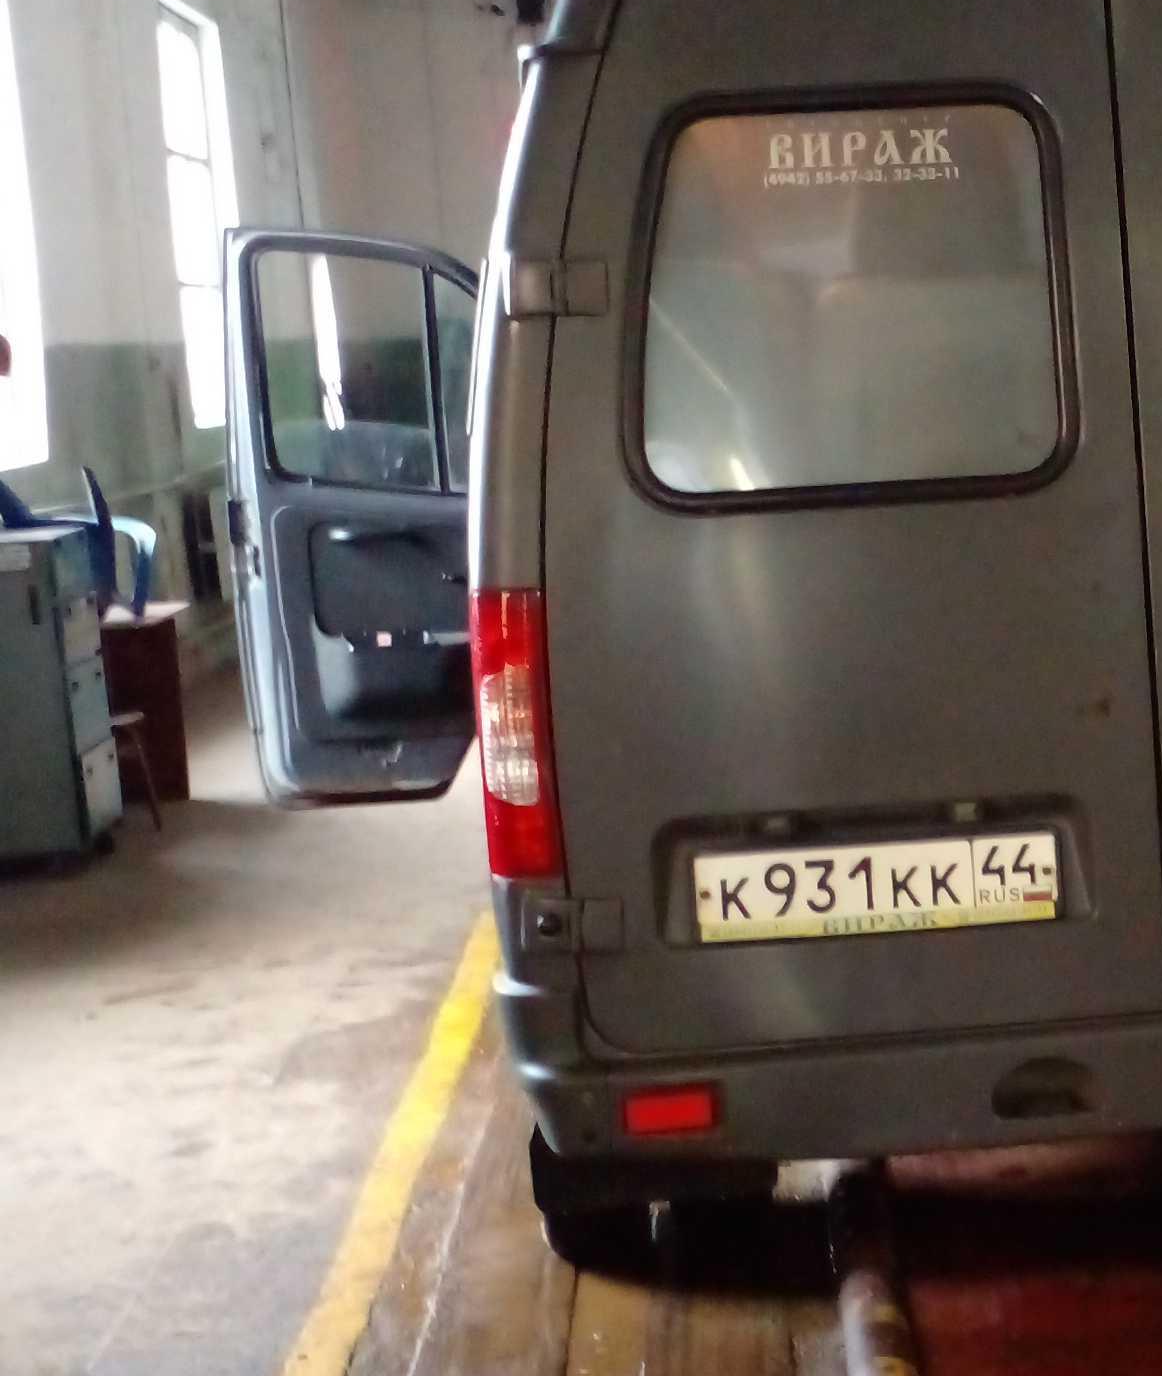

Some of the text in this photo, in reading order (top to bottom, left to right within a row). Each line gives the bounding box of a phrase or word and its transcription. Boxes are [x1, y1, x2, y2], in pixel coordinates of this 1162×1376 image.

[768, 127, 953, 169] ВИРАЖ
[718, 843, 1038, 921] К931КК 44
[979, 886, 1021, 904] RUS
